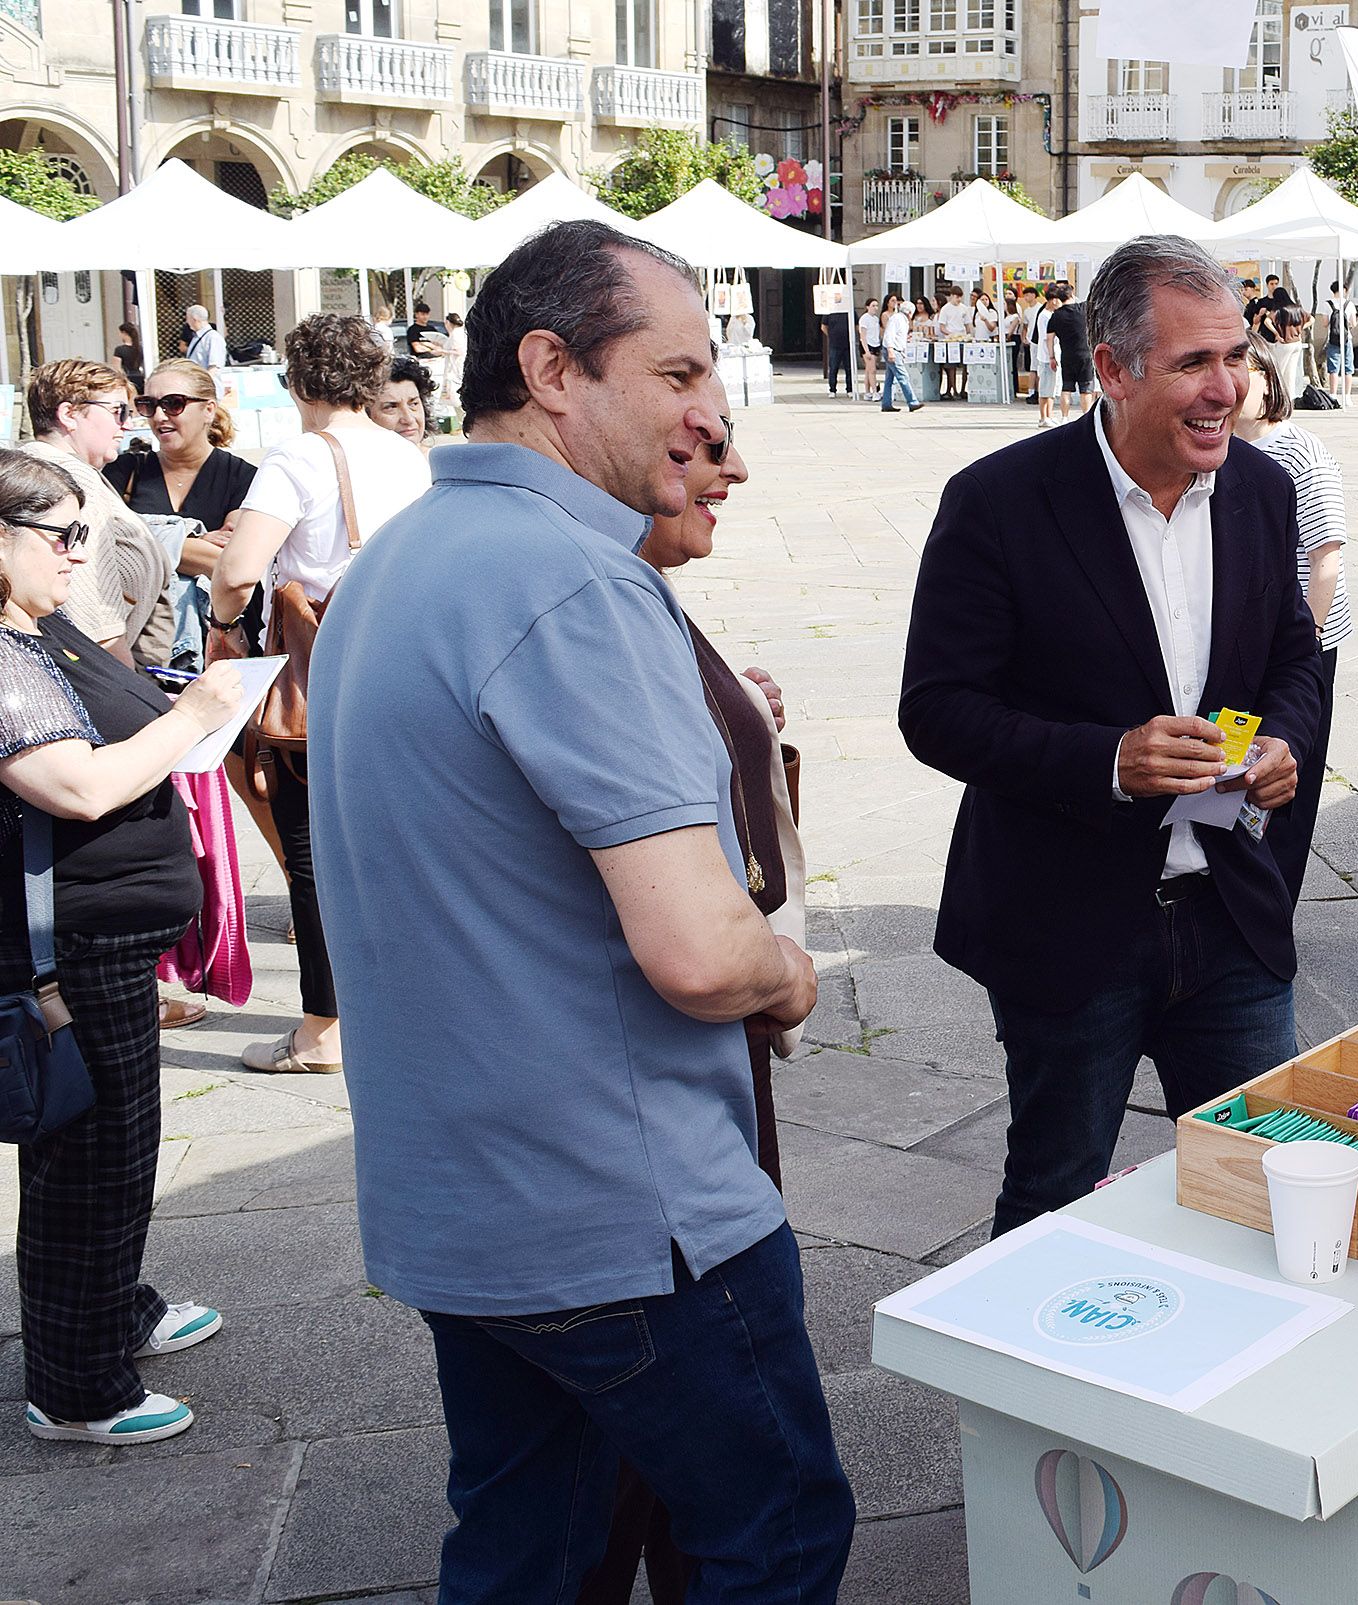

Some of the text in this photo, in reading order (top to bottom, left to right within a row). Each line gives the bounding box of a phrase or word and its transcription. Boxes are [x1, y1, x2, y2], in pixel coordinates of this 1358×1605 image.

[1232, 165, 1261, 174] Carabela
[1108, 1281, 1155, 1291] INFUSIONS
[1061, 1299, 1134, 1331] CIAN
